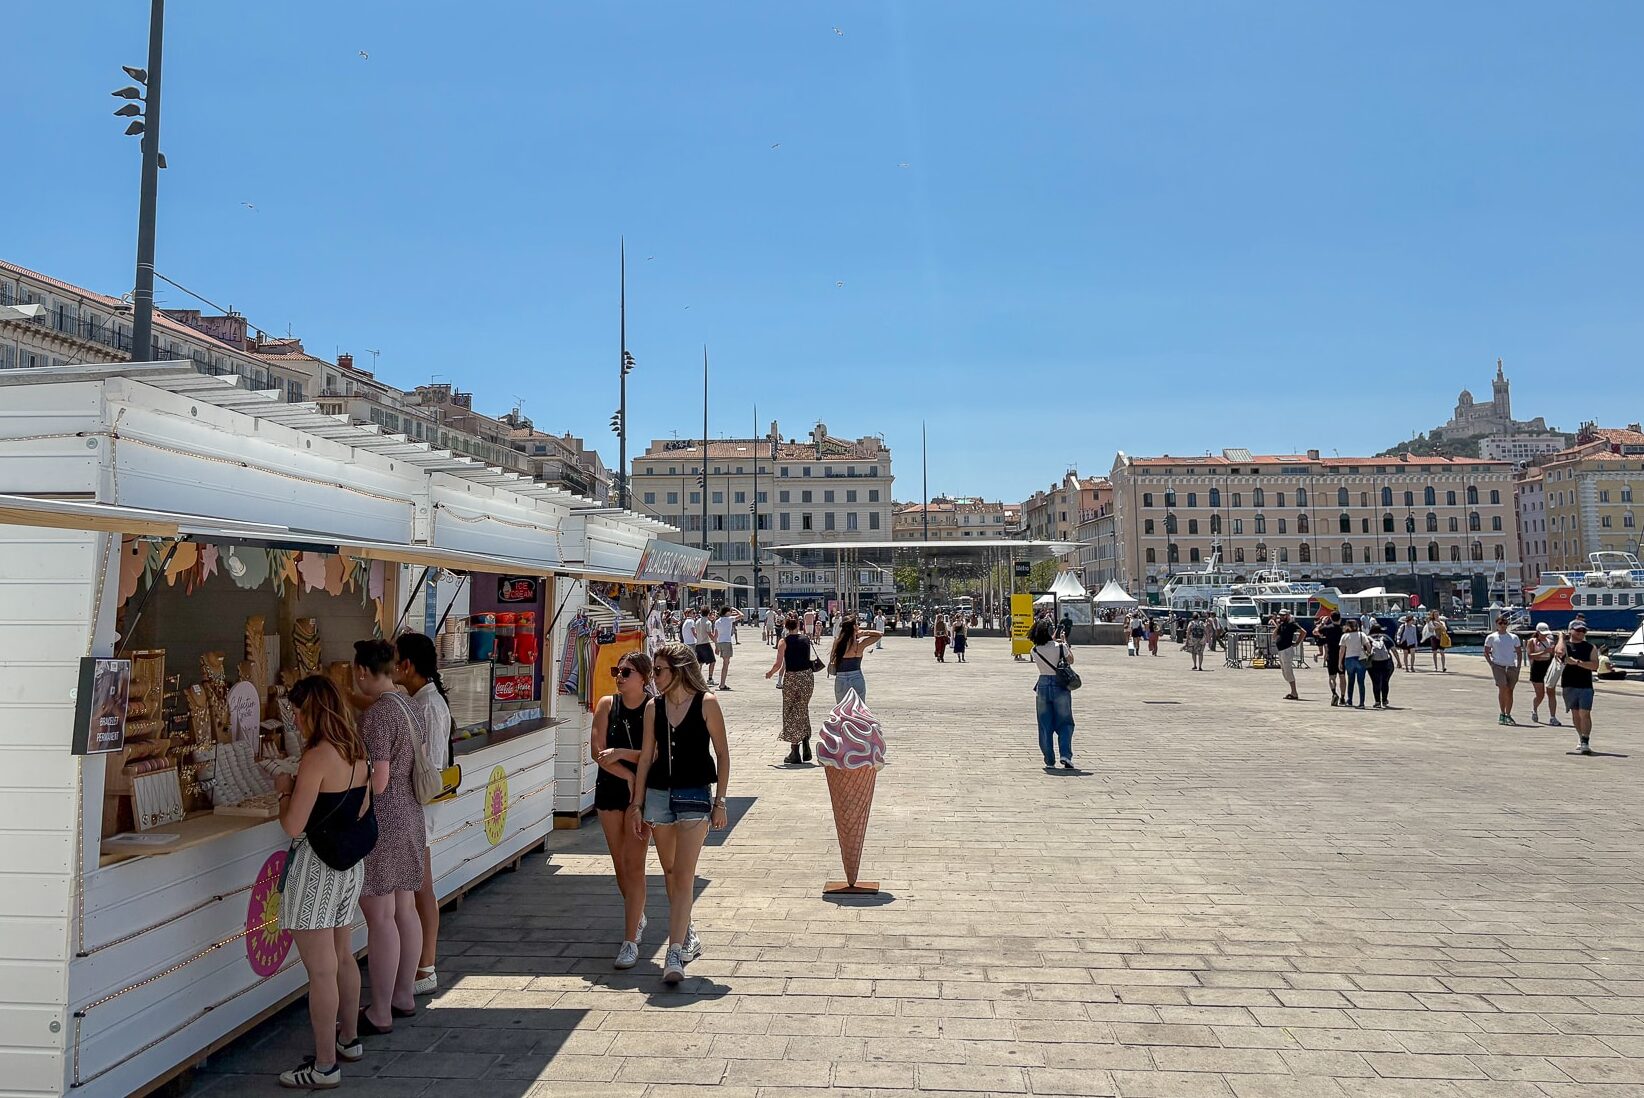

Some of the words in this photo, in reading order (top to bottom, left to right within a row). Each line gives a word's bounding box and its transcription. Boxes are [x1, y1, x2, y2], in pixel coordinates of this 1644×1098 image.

[644, 548, 674, 574] GLACES
[515, 582, 529, 590] ICE
[510, 590, 534, 598] CREAM
[99, 716, 120, 726] BRACELET
[96, 731, 120, 742] PERMANENT
